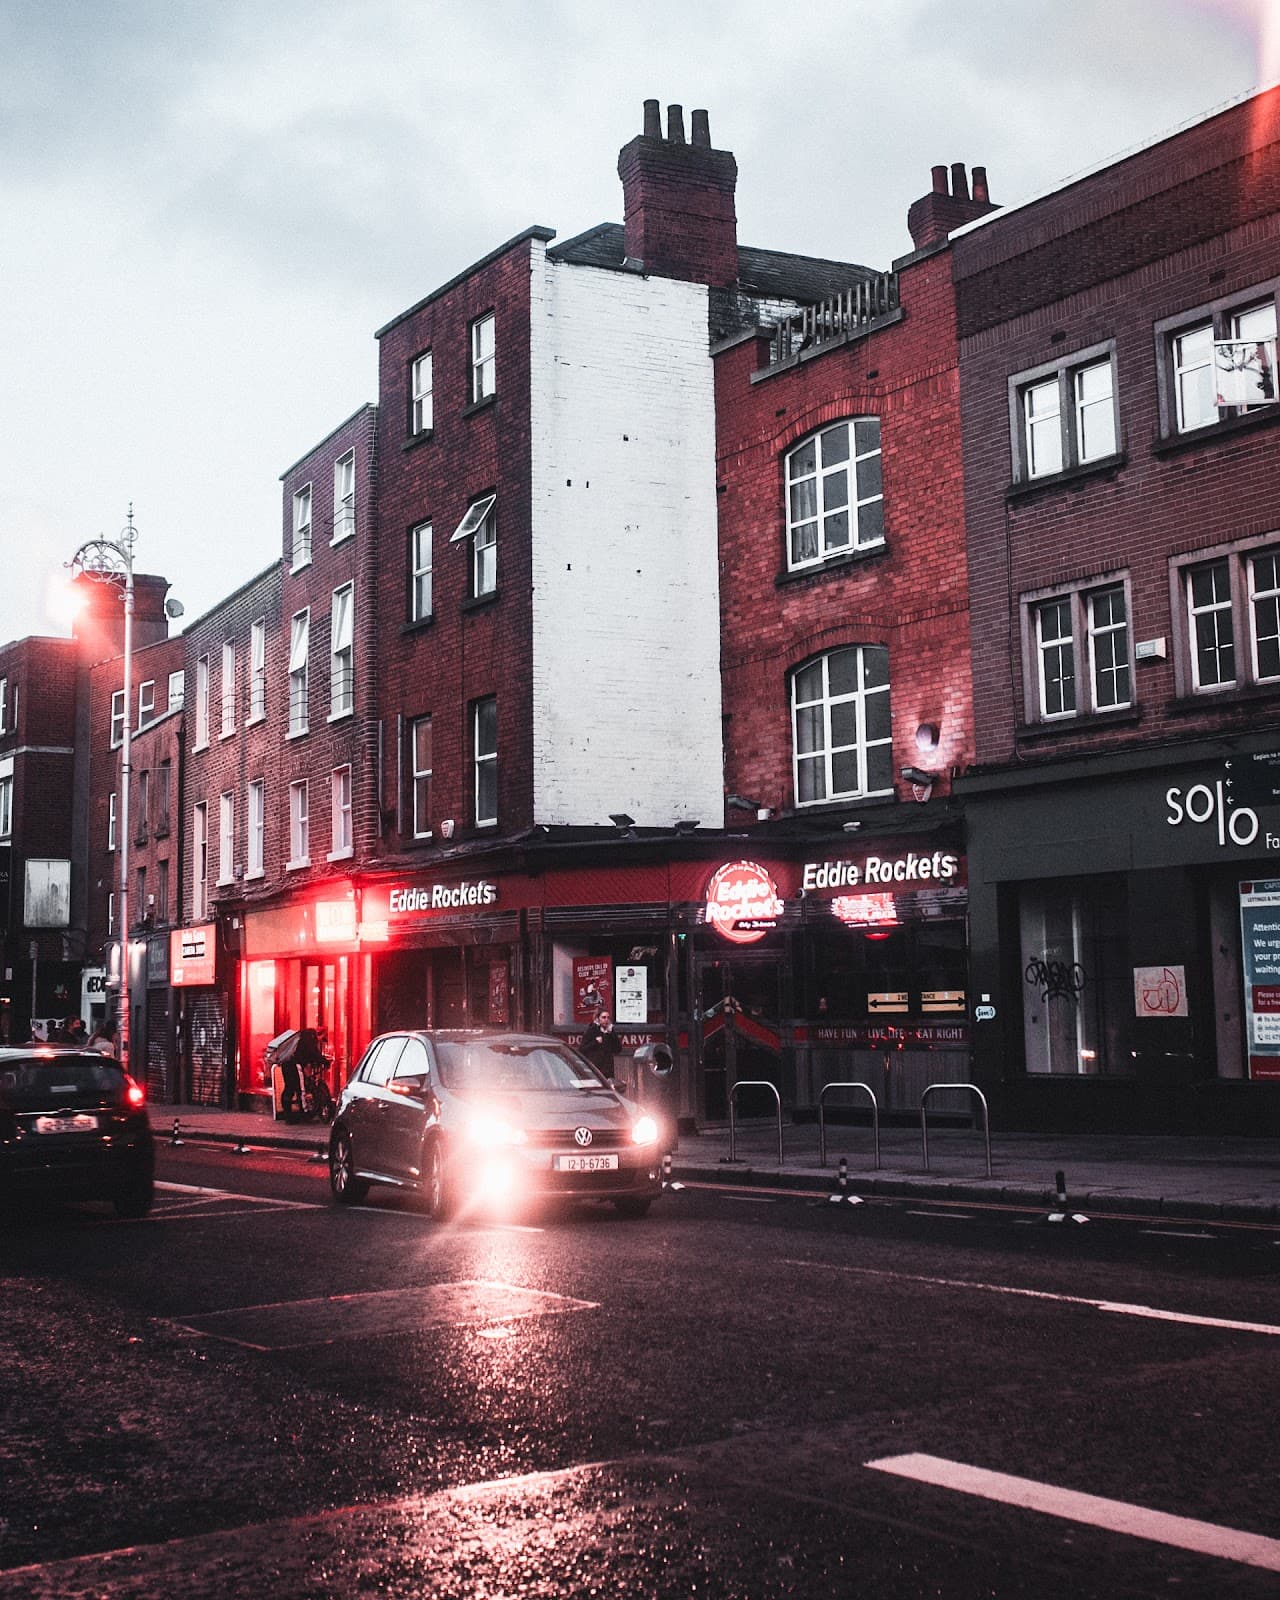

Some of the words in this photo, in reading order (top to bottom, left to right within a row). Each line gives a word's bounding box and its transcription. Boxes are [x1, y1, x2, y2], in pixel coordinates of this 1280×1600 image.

[1166, 780, 1259, 846] solo
[803, 859, 861, 890] Eddie
[865, 851, 957, 884] Rockets
[389, 886, 429, 912] Eddie
[431, 880, 496, 909] Rockets
[717, 878, 771, 902] Eddie
[1253, 939, 1266, 948] We
[1254, 954, 1271, 962] your
[818, 1028, 838, 1039] HAVE
[867, 1027, 885, 1039] LIVE
[917, 1027, 933, 1039] EAT
[936, 1027, 964, 1039] RIGHT
[568, 1157, 610, 1171] 12-D-6736
